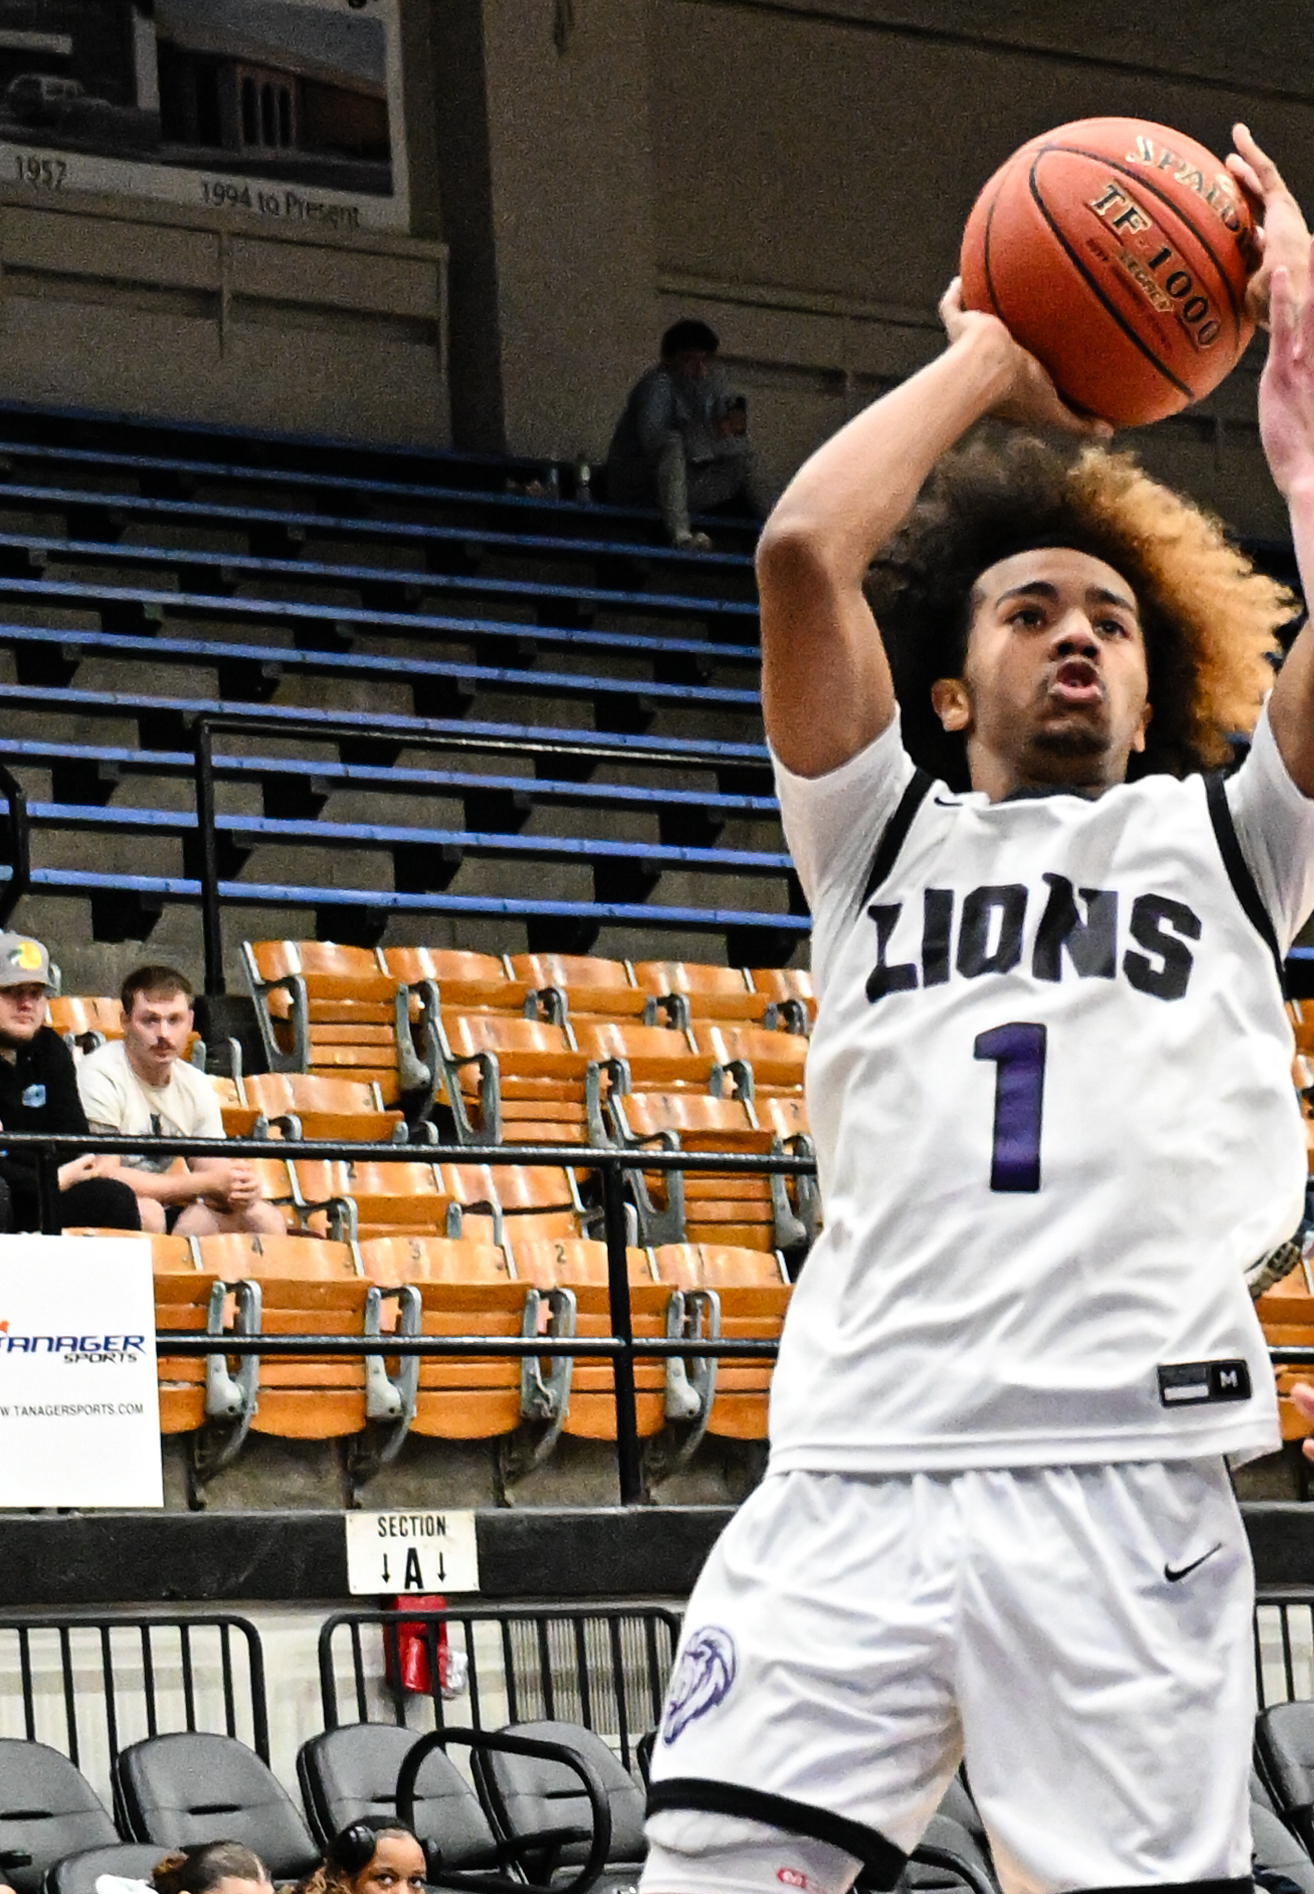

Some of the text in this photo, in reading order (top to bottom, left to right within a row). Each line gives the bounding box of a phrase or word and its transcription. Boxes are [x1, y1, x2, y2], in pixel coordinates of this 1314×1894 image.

[15, 155, 67, 190] 1957
[257, 190, 279, 216] to
[866, 872, 1202, 1003] LIONS
[974, 1021, 1047, 1193] 1
[64, 1353, 138, 1363] SPORTS
[1220, 1370, 1238, 1388] M
[377, 1515, 446, 1537] SECTION
[405, 1547, 424, 1590] A
